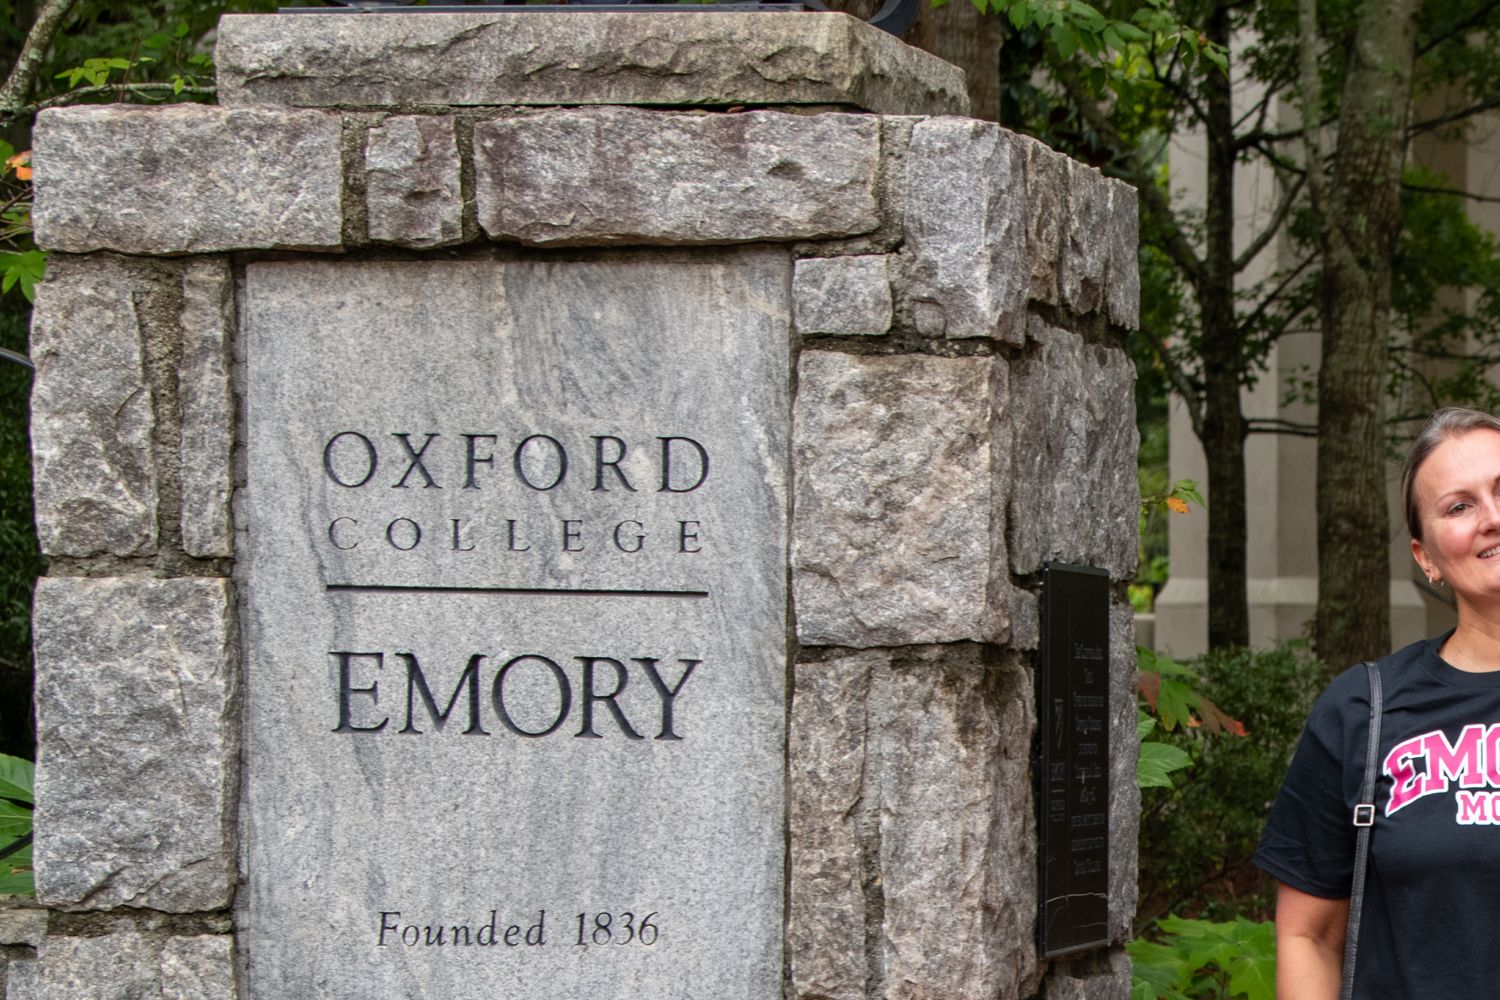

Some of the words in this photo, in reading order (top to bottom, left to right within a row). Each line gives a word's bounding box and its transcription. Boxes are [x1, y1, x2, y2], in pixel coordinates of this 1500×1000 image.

[322, 430, 710, 494] OXFORD
[327, 515, 703, 554] COLLEGE
[328, 650, 703, 741] EMORY
[376, 909, 546, 947] Founded
[573, 910, 660, 948] 1836
